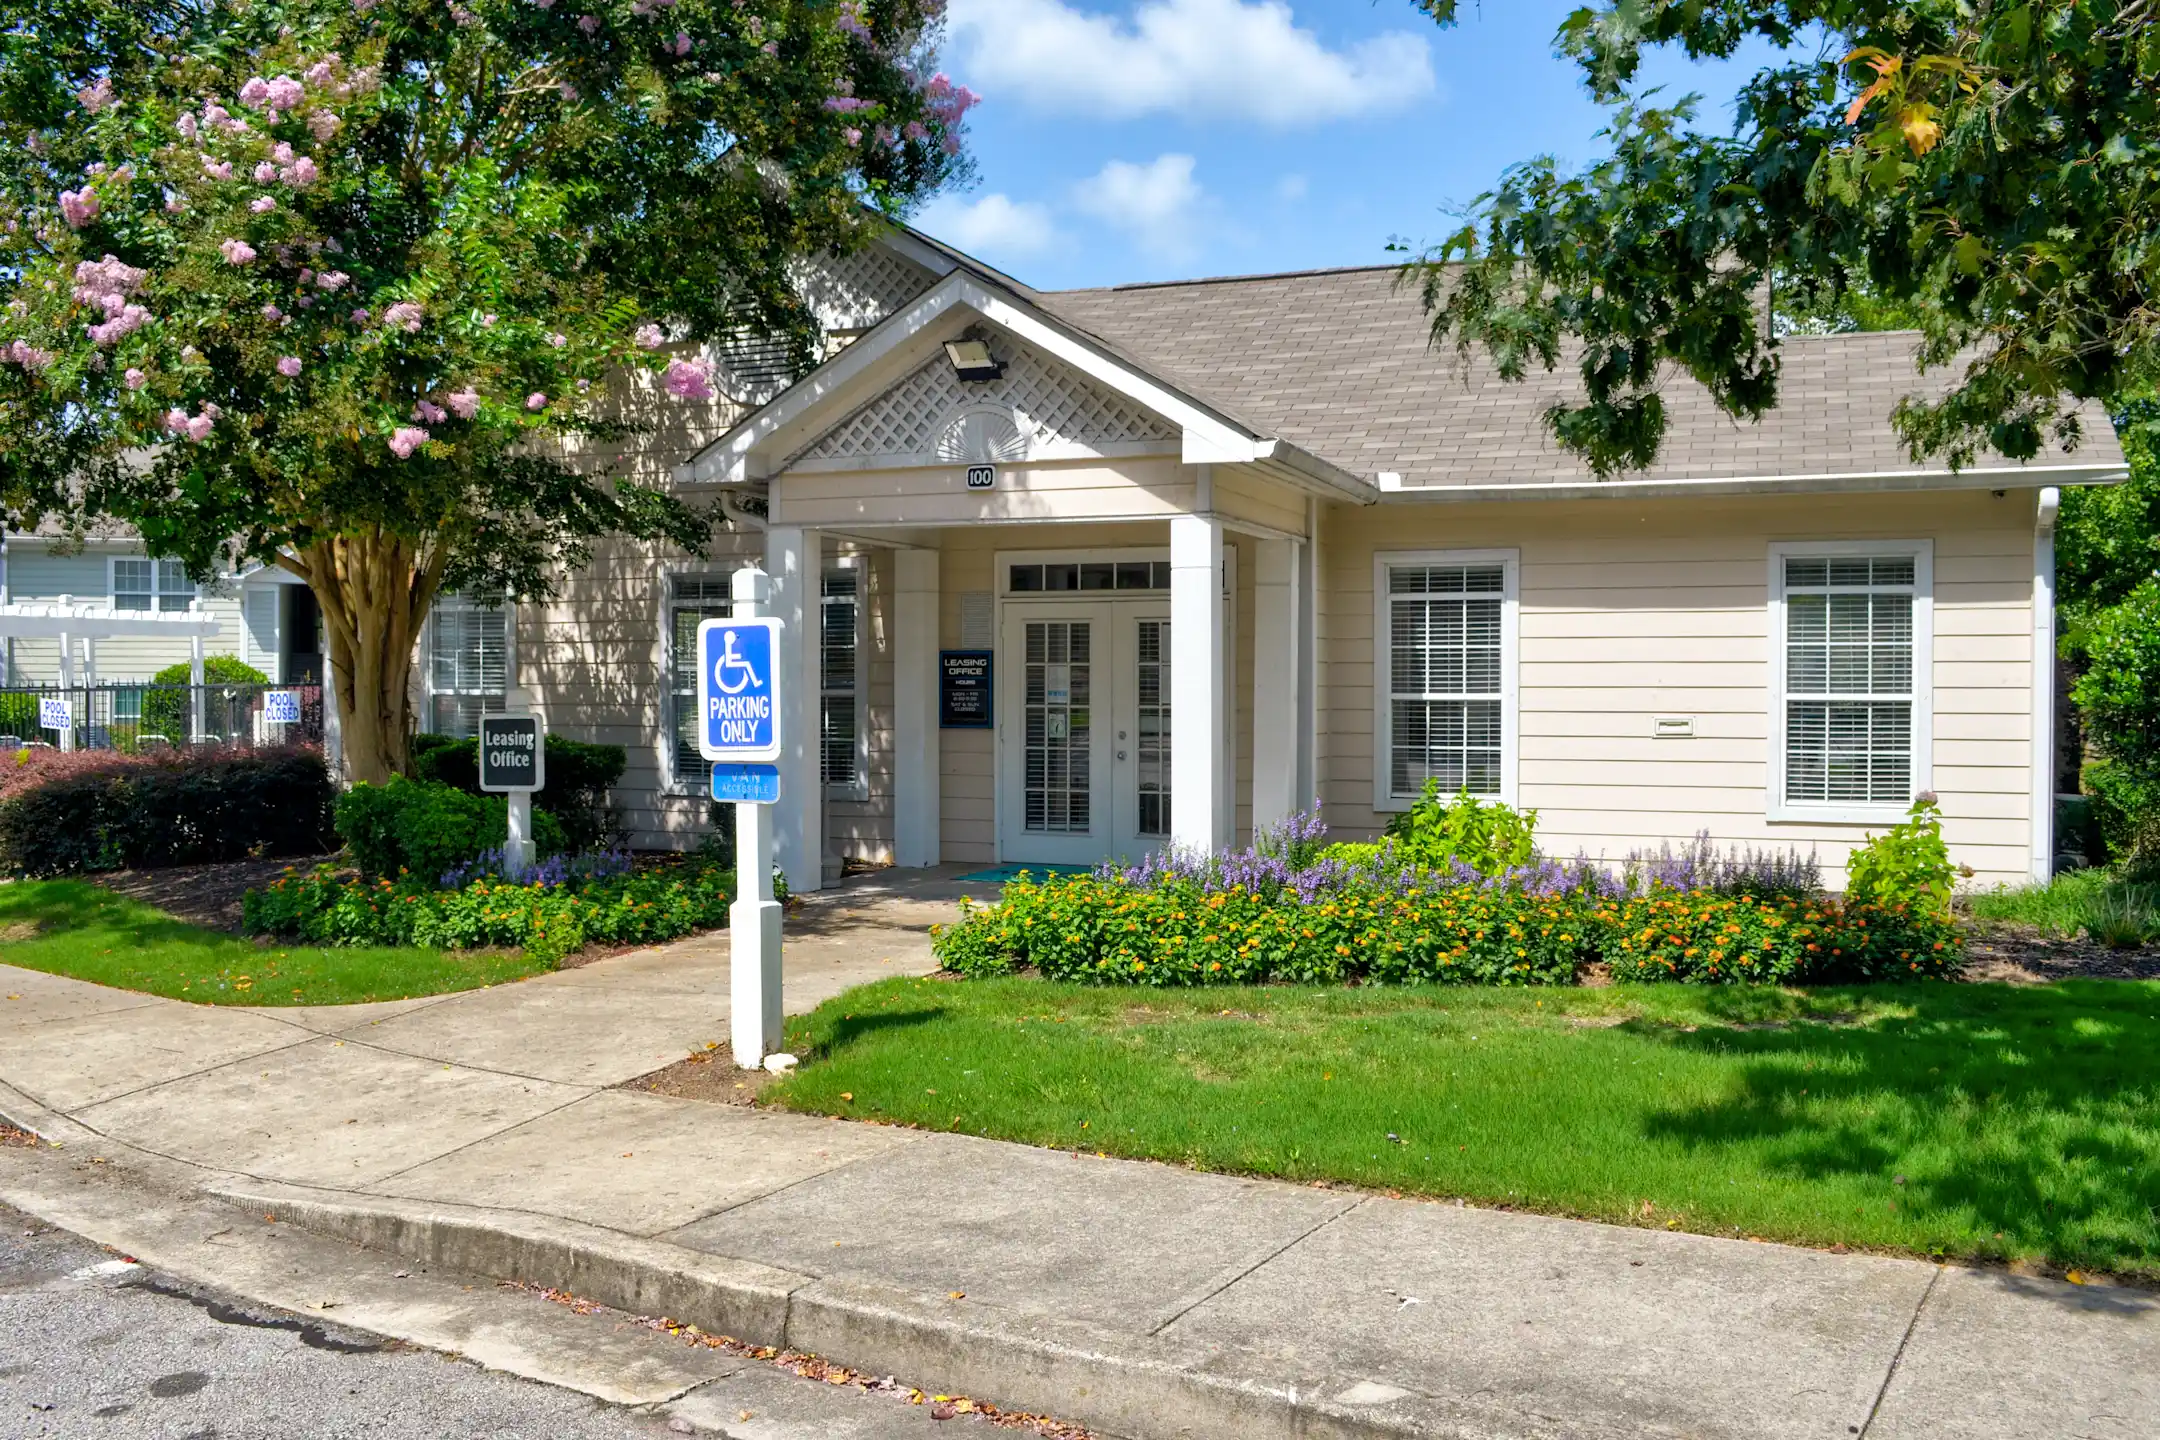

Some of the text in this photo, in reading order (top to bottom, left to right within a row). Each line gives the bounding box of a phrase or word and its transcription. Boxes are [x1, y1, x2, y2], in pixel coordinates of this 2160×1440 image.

[970, 470, 992, 485] 100
[944, 658, 988, 667] LEASING
[948, 667, 983, 675] OFFICE
[269, 693, 295, 706] POOL
[45, 701, 66, 715] POOL
[265, 707, 299, 721] CLOSED
[709, 696, 769, 719] PARKING
[42, 714, 70, 728] CLOSED
[721, 719, 759, 743] ONLY
[485, 730, 534, 750] Leasing
[490, 751, 530, 767] Office
[722, 783, 769, 794] ACCESSIBLE
